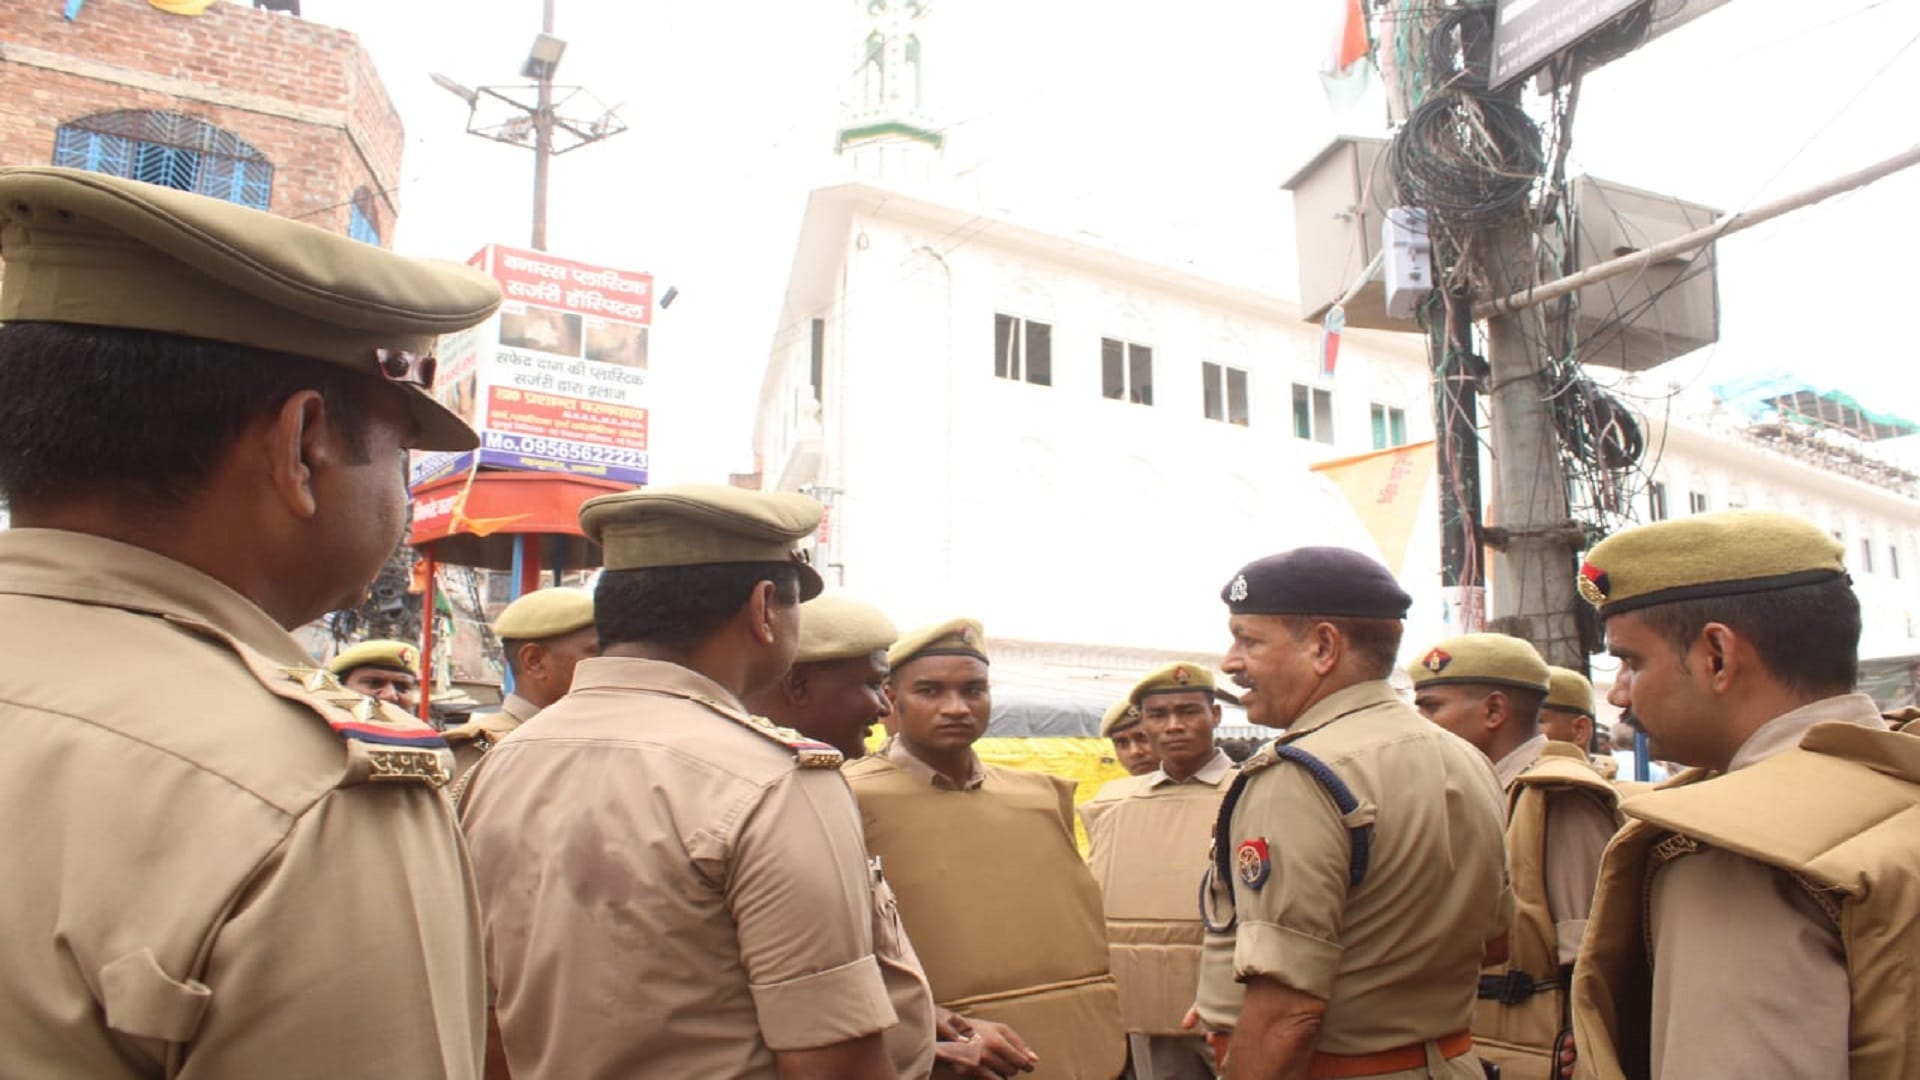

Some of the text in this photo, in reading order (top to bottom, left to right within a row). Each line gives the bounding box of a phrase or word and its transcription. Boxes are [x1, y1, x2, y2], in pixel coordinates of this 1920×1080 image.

[503, 255, 647, 295] बनारस प्लास्टिक
[506, 280, 645, 318] सर्जरी हॉस्पिटल
[495, 349, 533, 368] सफेद
[567, 361, 586, 376] की
[589, 367, 644, 386] प्लास्टिक
[513, 373, 553, 388] सर्जरी
[557, 380, 583, 396] द्वारा
